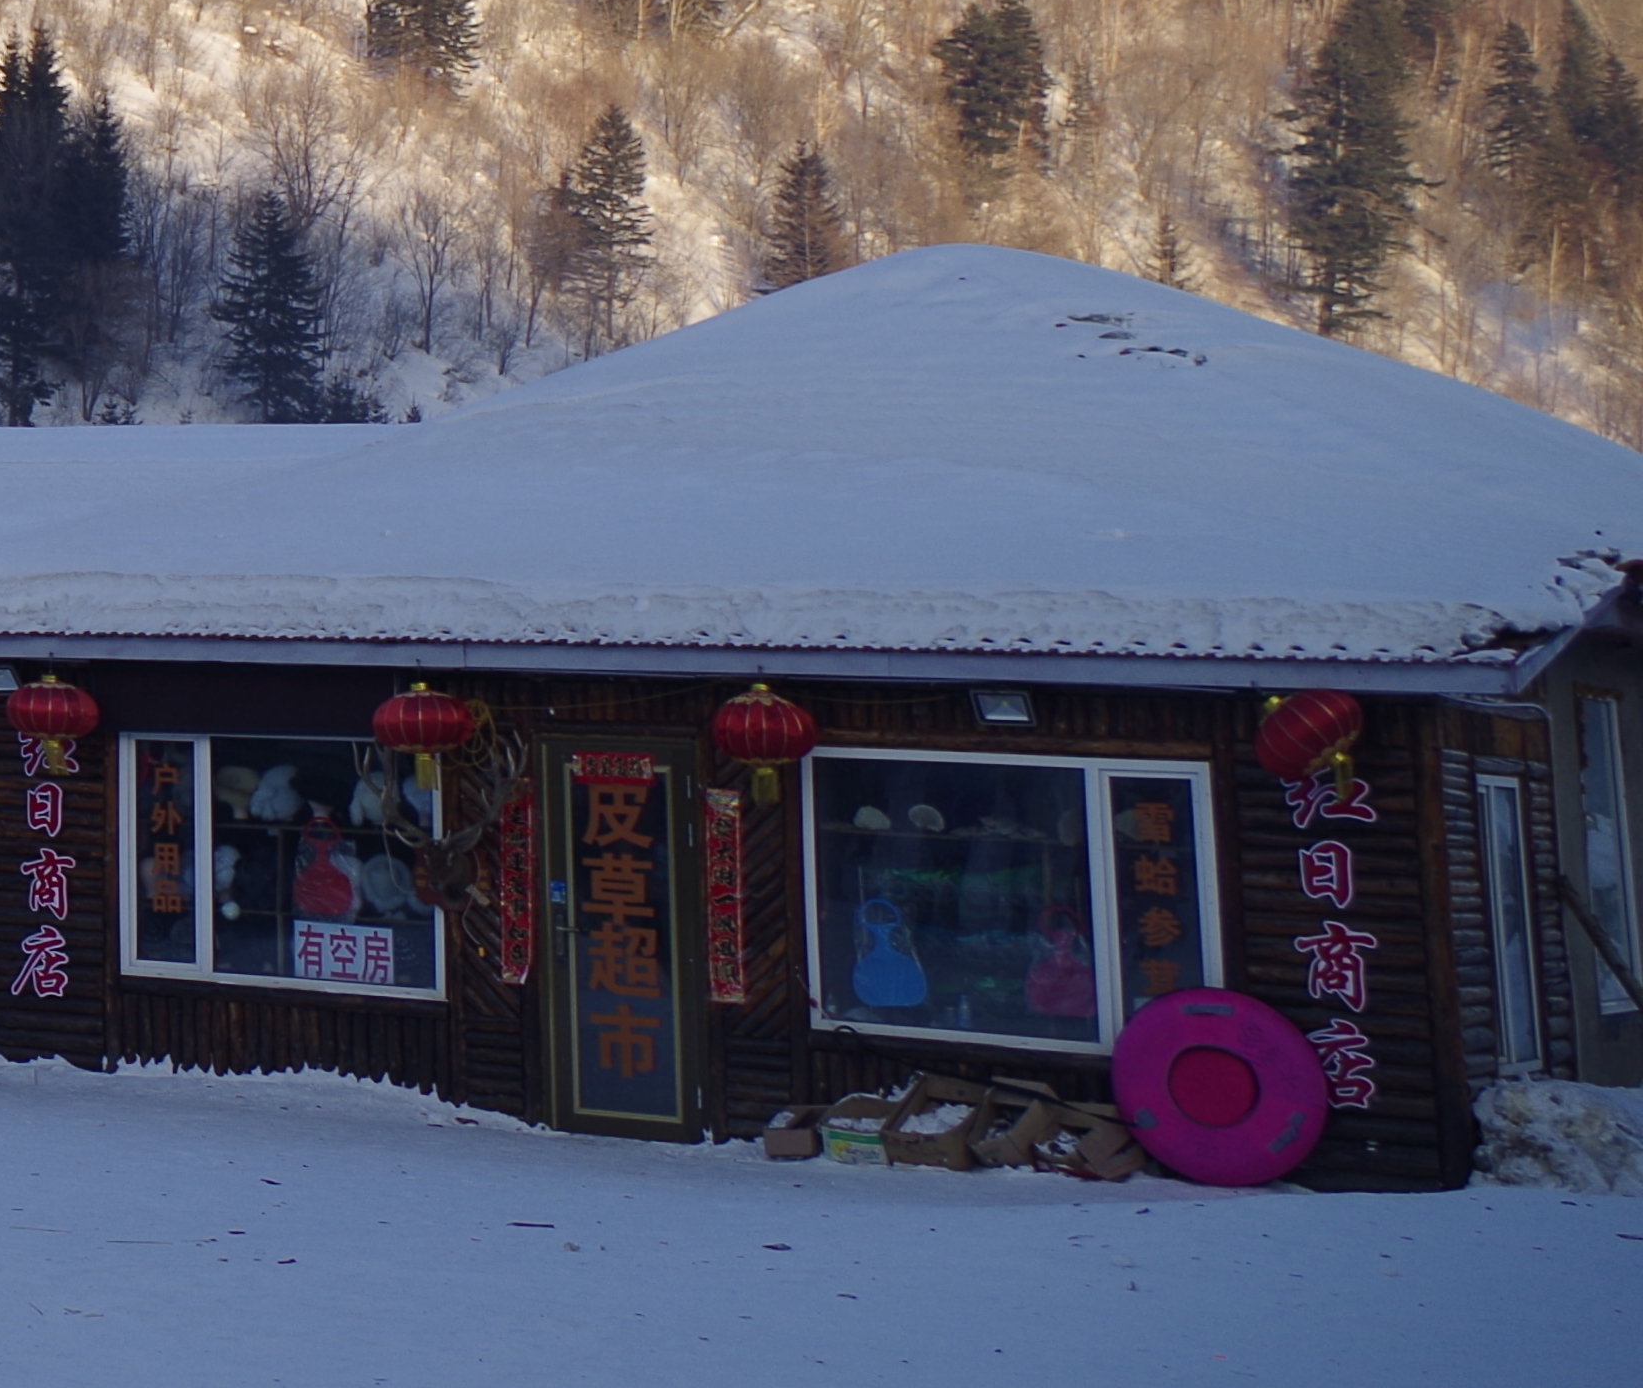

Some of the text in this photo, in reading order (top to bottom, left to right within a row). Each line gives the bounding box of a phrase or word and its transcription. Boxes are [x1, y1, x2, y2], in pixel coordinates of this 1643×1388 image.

[150, 762, 183, 914] 户外用品
[581, 783, 662, 1078] 皮草超市
[1279, 768, 1377, 1109] 红日商店
[297, 924, 392, 984] 有空房
